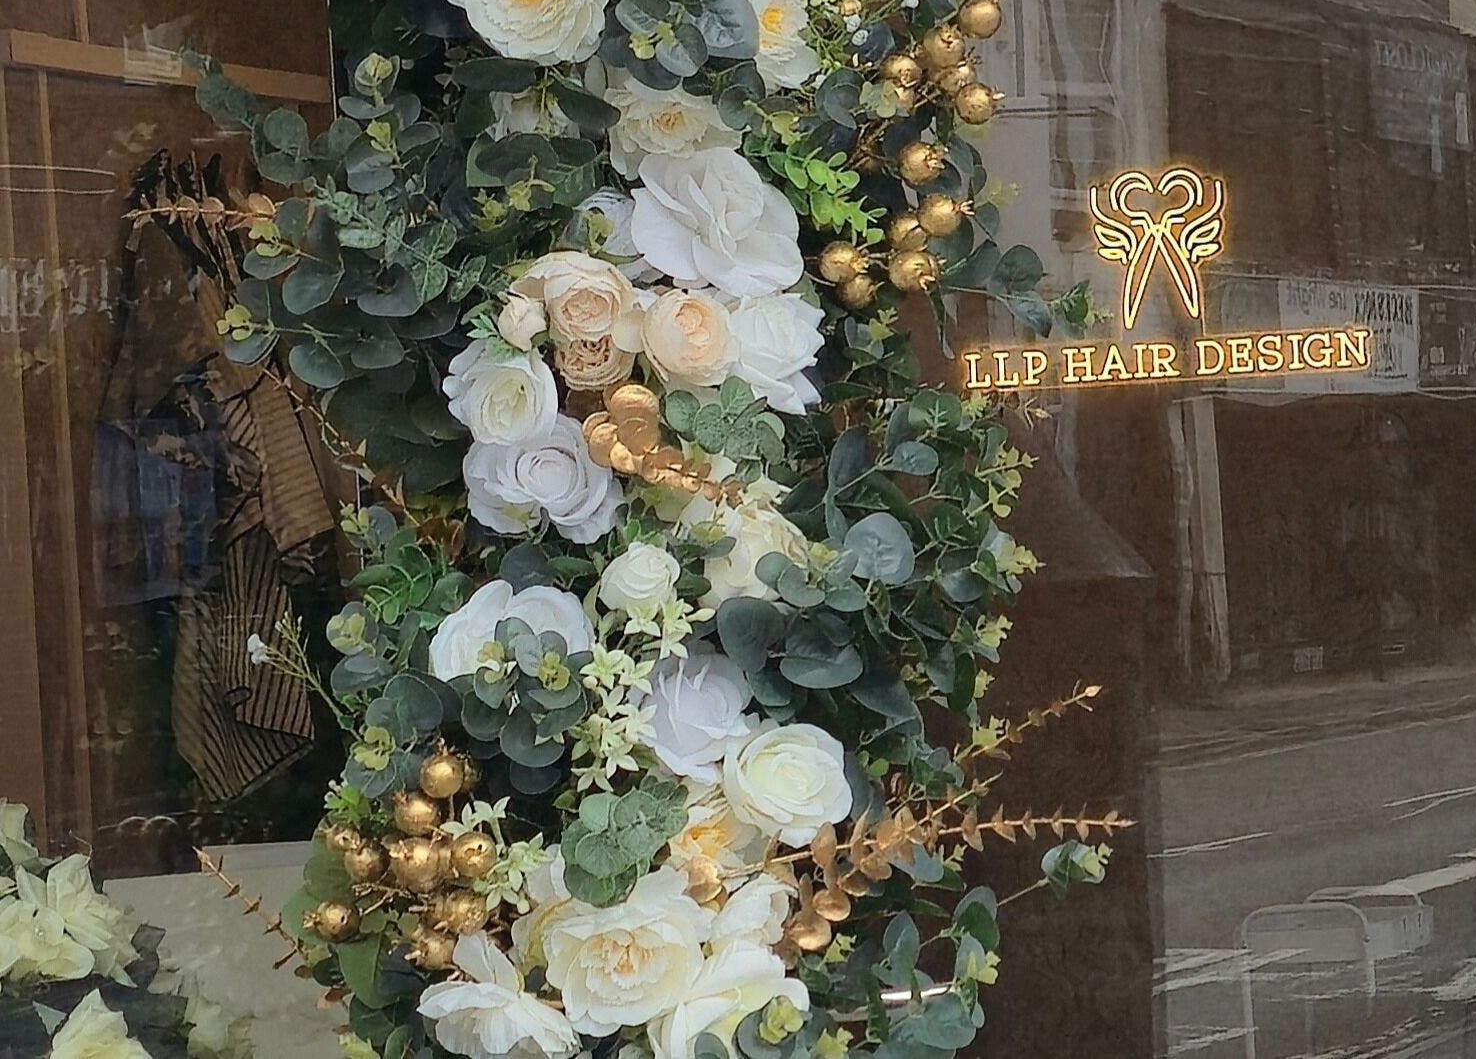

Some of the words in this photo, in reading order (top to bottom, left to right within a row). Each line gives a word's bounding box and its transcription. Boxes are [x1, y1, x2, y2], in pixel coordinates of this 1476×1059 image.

[964, 351, 1049, 391] LLP
[1061, 343, 1182, 385] HAIR
[1195, 329, 1371, 376] DESIGN
